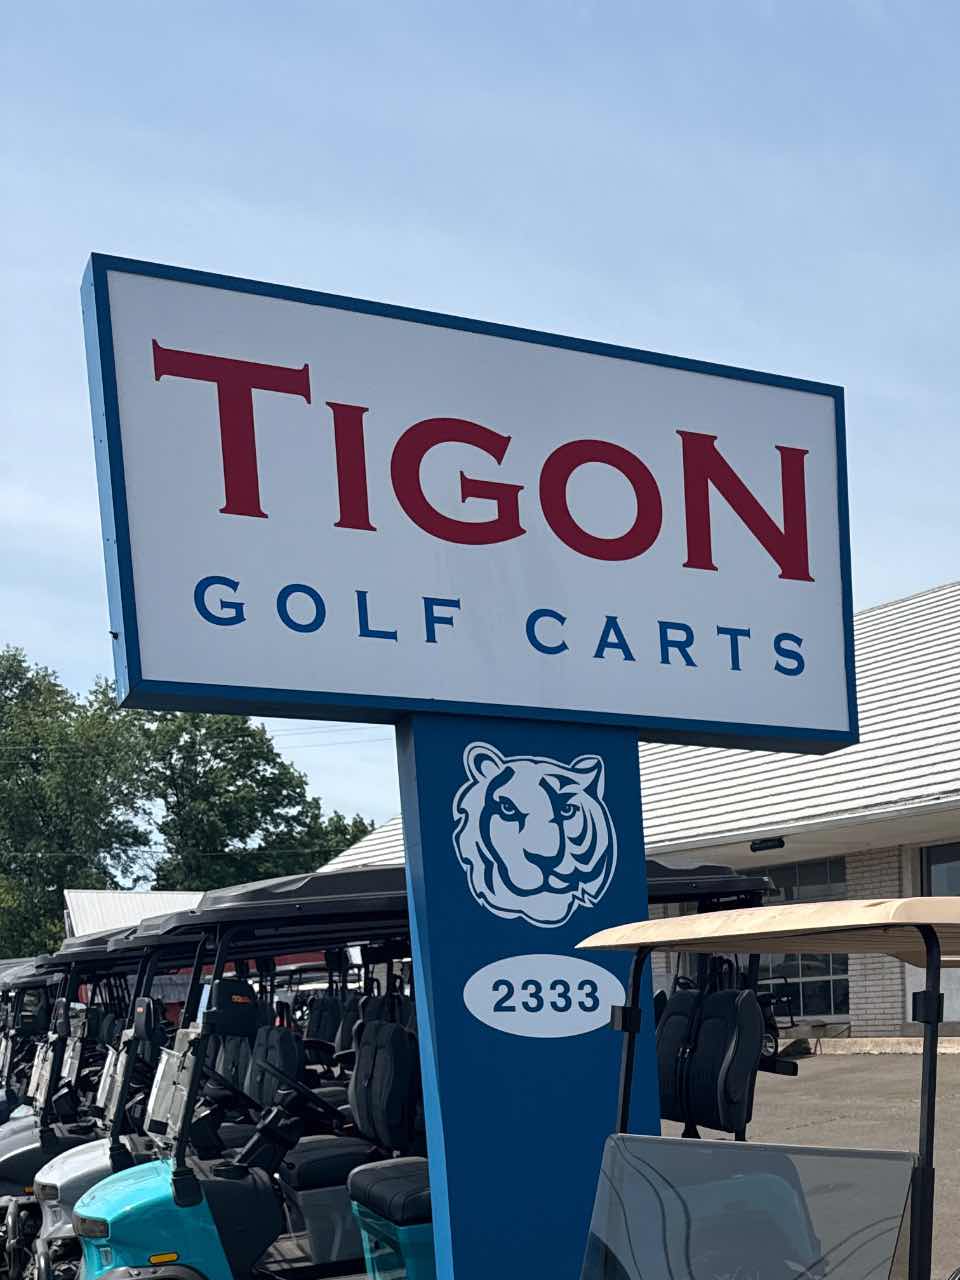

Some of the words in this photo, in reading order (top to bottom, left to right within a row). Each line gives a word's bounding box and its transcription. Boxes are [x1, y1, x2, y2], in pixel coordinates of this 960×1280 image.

[193, 575, 461, 644] GOLF
[525, 608, 806, 677] CARTS
[491, 979, 600, 1013] 2333
